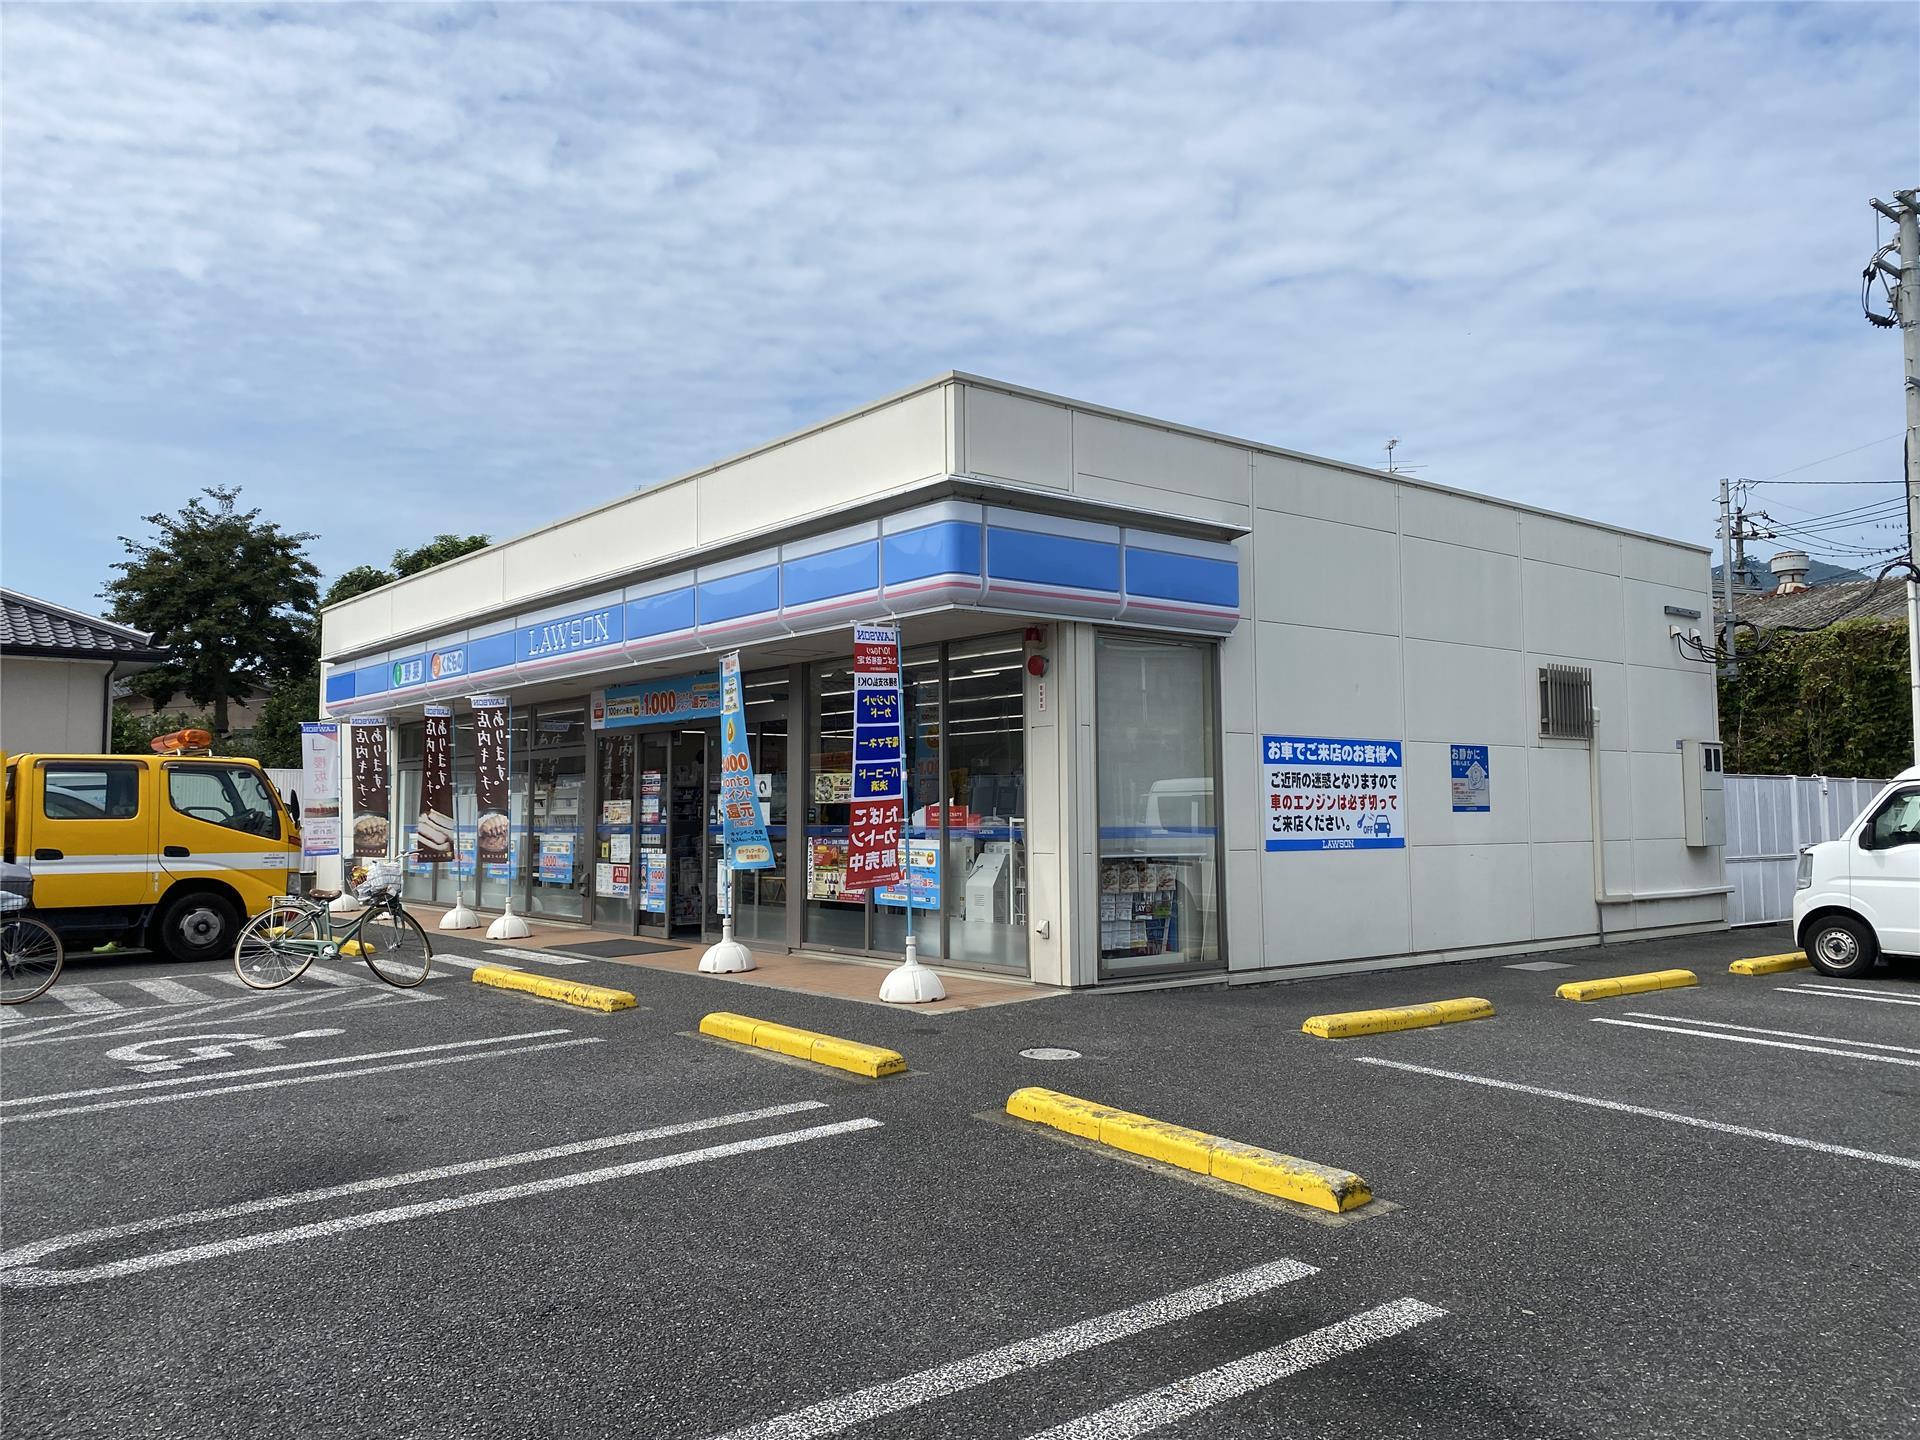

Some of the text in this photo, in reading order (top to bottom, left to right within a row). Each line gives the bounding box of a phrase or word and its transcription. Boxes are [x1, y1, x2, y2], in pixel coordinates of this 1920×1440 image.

[528, 611, 609, 656] LAWSON
[442, 651, 463, 672] くだもの
[404, 662, 420, 681] 野菜
[1267, 741, 1398, 763] お車でご来店のお客様へ
[1451, 748, 1481, 761] お静かに
[1271, 771, 1397, 790] ご近所の迷惑となりますので
[725, 802, 755, 820] 還元
[1271, 793, 1398, 811] 車のエンジンは必ず切って
[1271, 814, 1351, 833] ご来店ください。
[1363, 826, 1373, 835] OFF
[1322, 839, 1355, 849] LAWSON
[614, 867, 628, 877] ATM
